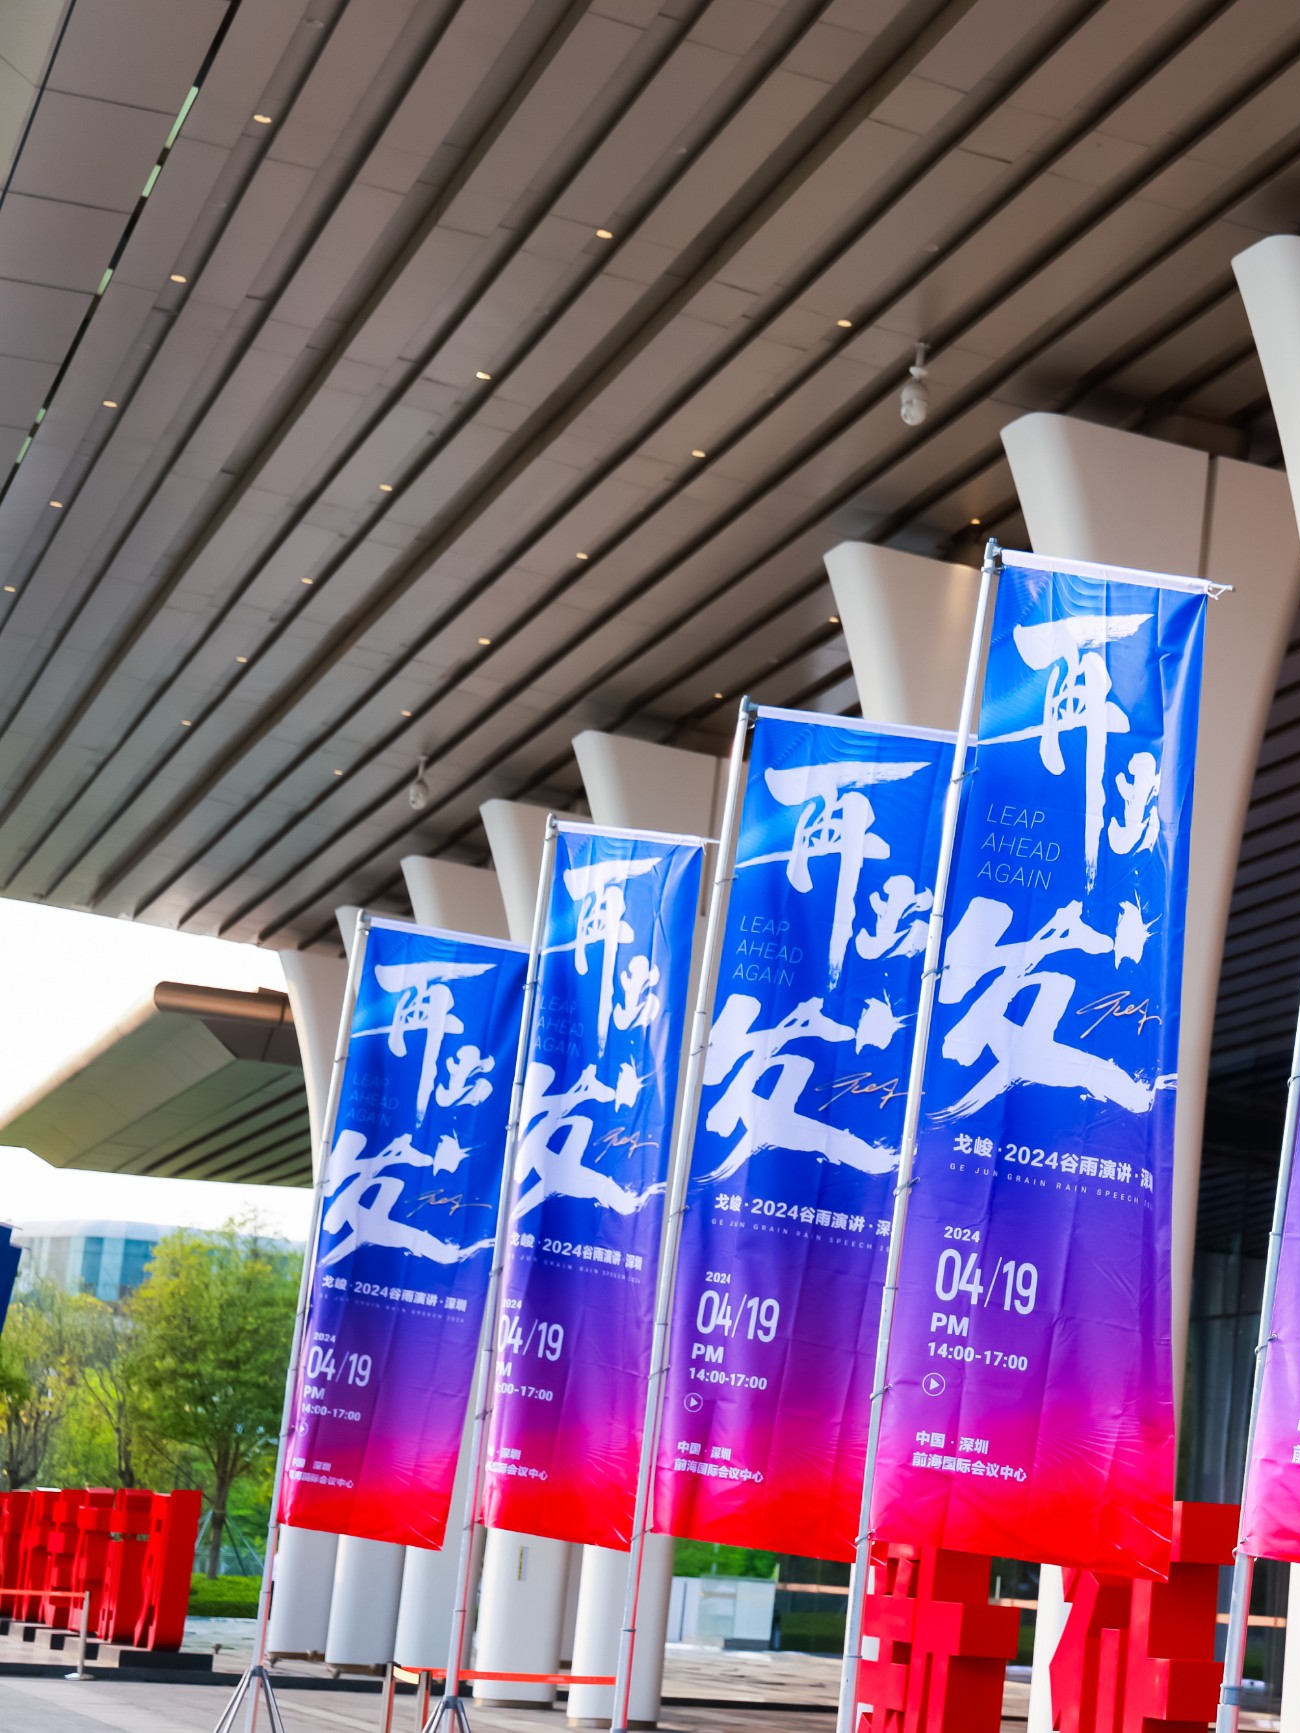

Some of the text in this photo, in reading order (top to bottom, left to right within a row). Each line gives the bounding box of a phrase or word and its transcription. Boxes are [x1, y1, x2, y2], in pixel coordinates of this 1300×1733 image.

[986, 803, 1045, 830] LEAP
[981, 832, 1061, 863] AHEAD
[977, 860, 1051, 890] AGAIN
[740, 915, 790, 936] LEAP
[735, 939, 804, 964] AHEAD
[732, 963, 795, 988] AGAIN
[1007, 1173, 1047, 1188] GRAIN
[1056, 1182, 1088, 1194] RAIN
[1096, 1188, 1140, 1205] SPEECH
[828, 1236, 873, 1251] SPEECH
[943, 1225, 981, 1243] 2024
[705, 1271, 730, 1284] 2024
[935, 1248, 1038, 1315] 04/19
[696, 1289, 780, 1343] 04/19
[930, 1312, 970, 1337] PM
[313, 1332, 336, 1343] 2024
[497, 1314, 564, 1362] 04/19
[306, 1345, 372, 1387] 04/19
[691, 1343, 724, 1364] PM
[927, 1341, 1029, 1371] 14:00-17:00
[688, 1366, 767, 1390] 14:00-17:00
[303, 1385, 326, 1400] PM
[911, 1451, 1028, 1483] 前海国际会议中心
